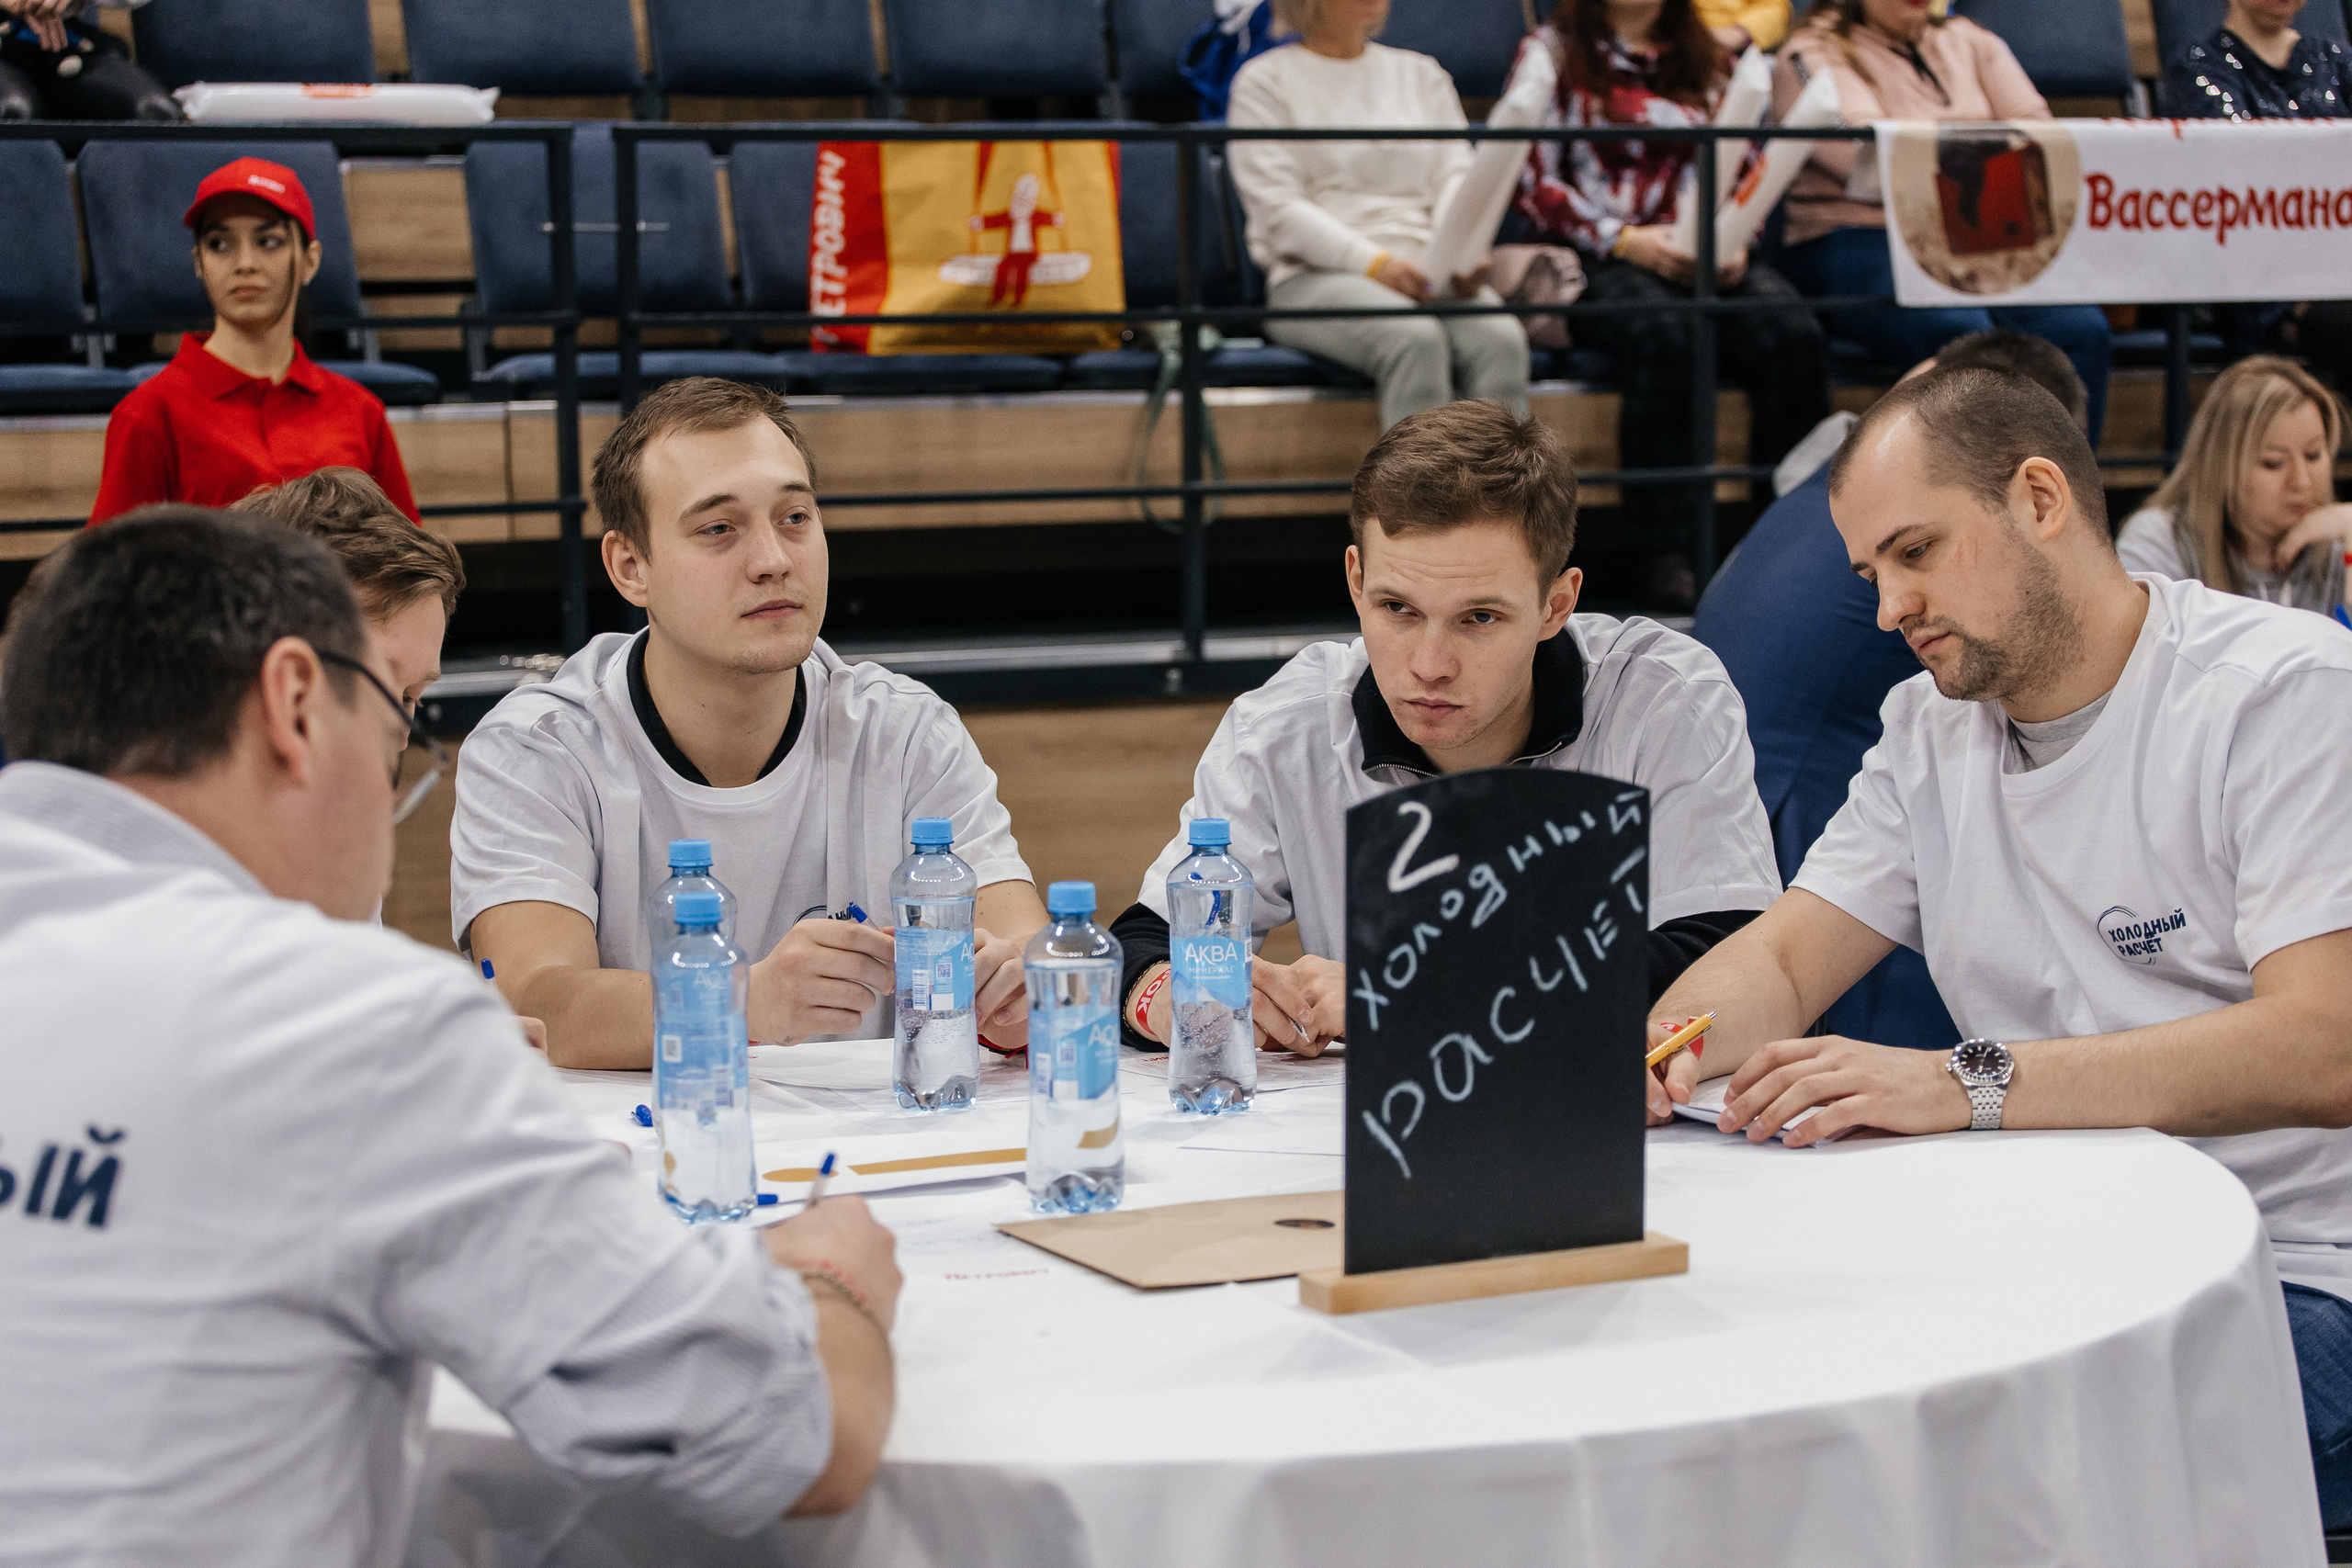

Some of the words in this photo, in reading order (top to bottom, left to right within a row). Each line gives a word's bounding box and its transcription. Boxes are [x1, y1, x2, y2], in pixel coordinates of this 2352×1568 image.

[2085, 171, 2352, 246] Вассермана
[1387, 799, 1460, 894] 2
[2108, 908, 2187, 943] ХОЛОДНЫЙ
[1184, 942, 1238, 965] АКВА
[2117, 937, 2164, 957] РАСЧЕТ
